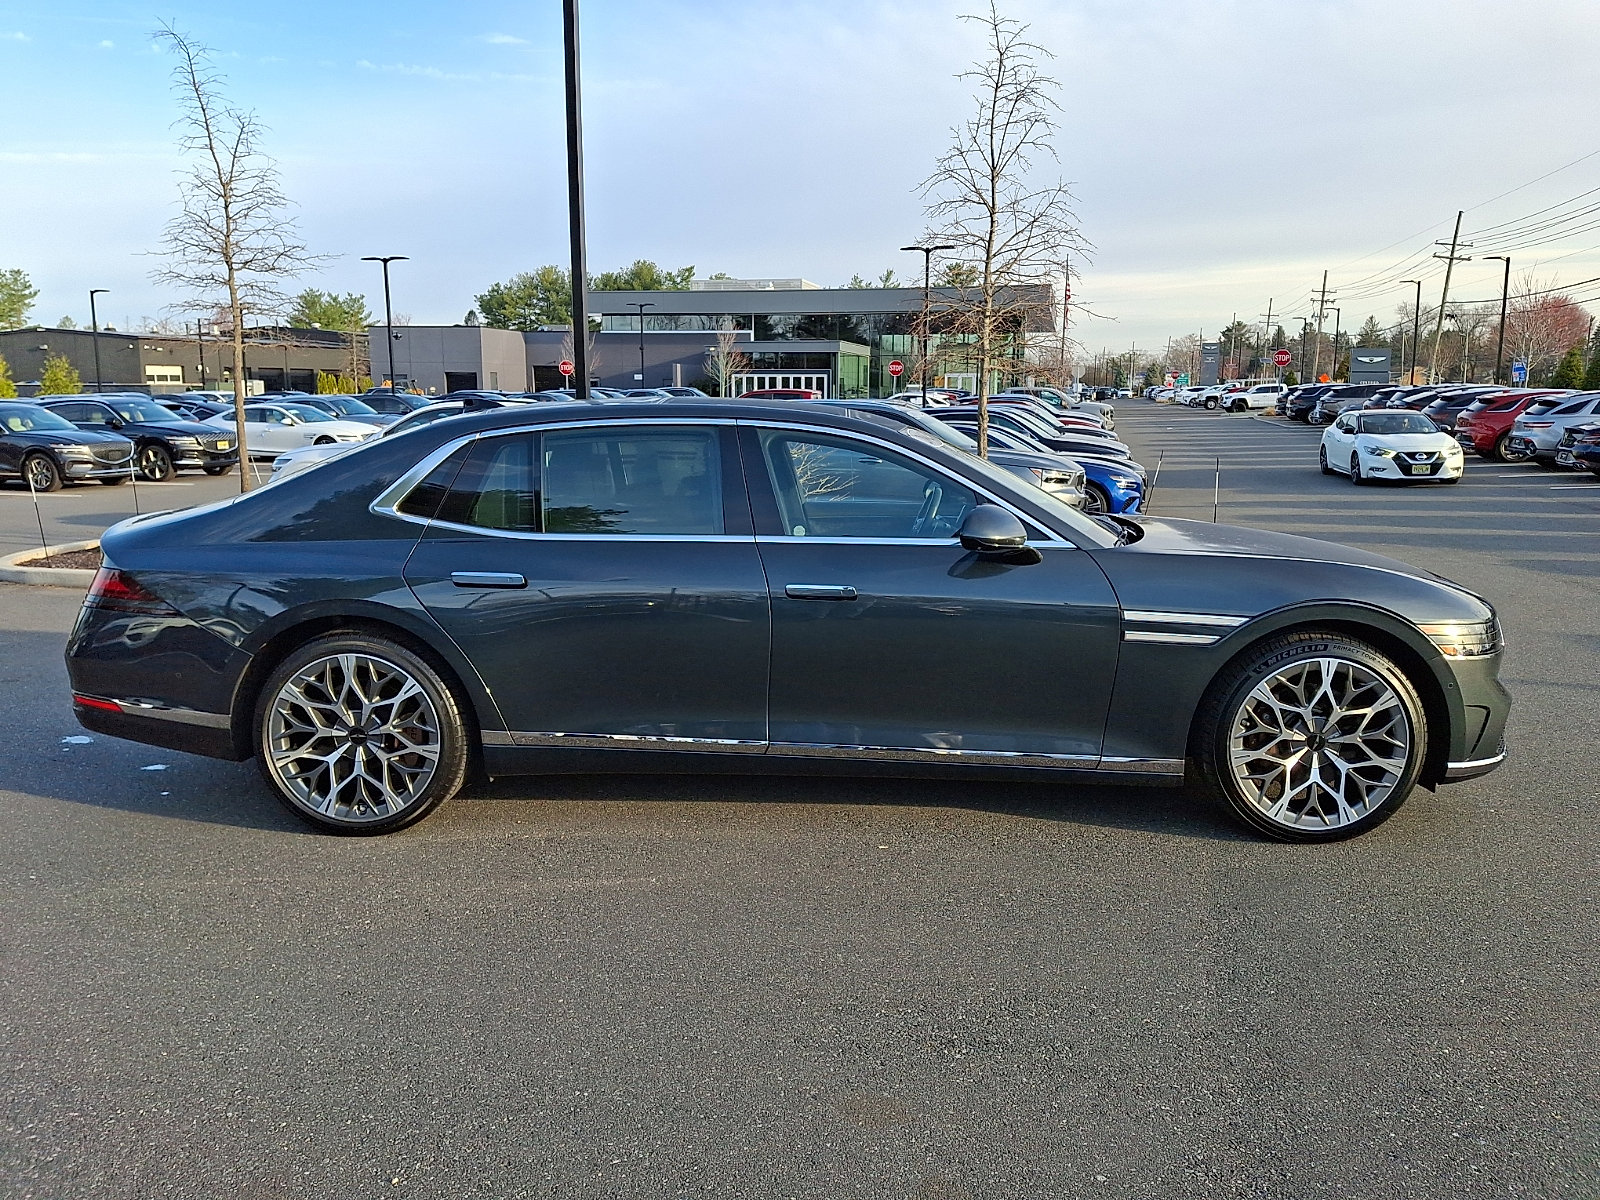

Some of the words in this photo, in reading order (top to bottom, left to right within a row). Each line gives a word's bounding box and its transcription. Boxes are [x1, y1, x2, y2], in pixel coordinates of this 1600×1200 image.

[1274, 354, 1290, 362] STOP
[889, 364, 903, 372] STOP
[1267, 644, 1325, 666] MICHELIN
